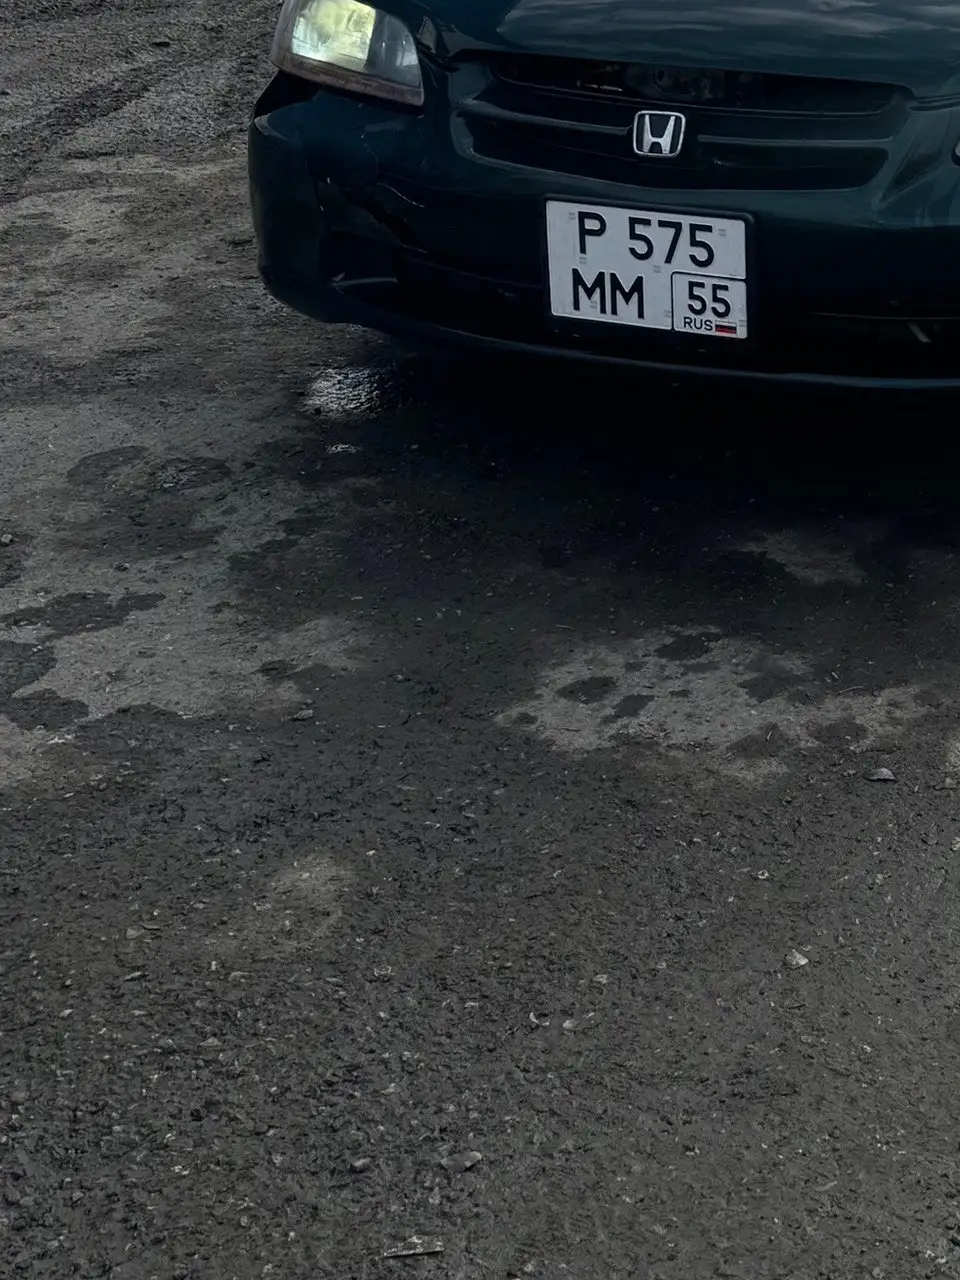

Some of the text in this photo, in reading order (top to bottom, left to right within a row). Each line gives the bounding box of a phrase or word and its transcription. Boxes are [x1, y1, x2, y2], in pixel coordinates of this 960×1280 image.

[628, 216, 715, 268] 575
[688, 280, 731, 318] 55
[683, 316, 713, 331] RUS
